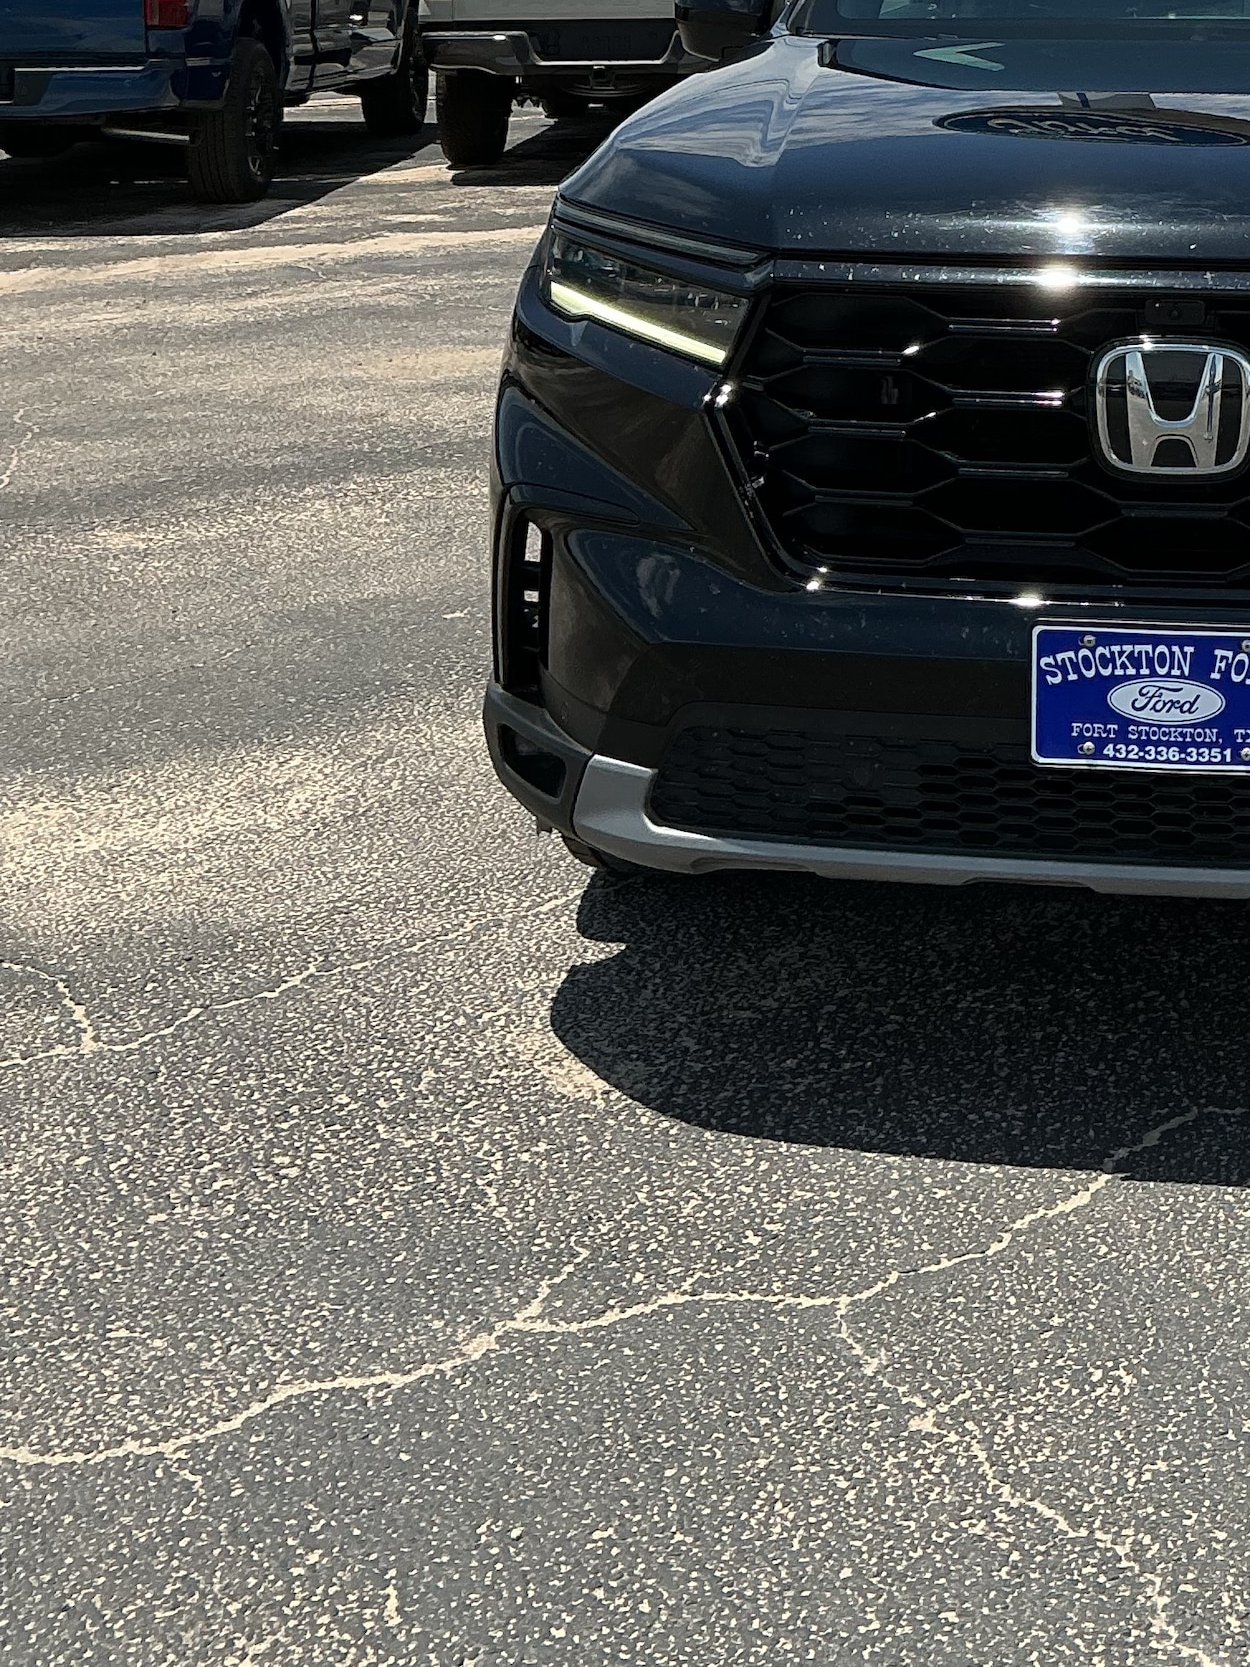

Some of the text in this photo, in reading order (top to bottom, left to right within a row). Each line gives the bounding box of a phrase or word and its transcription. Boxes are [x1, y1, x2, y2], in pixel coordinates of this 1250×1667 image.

[1039, 644, 1195, 685] STOCKTON
[1131, 684, 1200, 715] Ford
[1071, 723, 1118, 739] FORT
[1128, 724, 1223, 744] STOCKTON,
[1103, 743, 1232, 763] 432-336-3351
